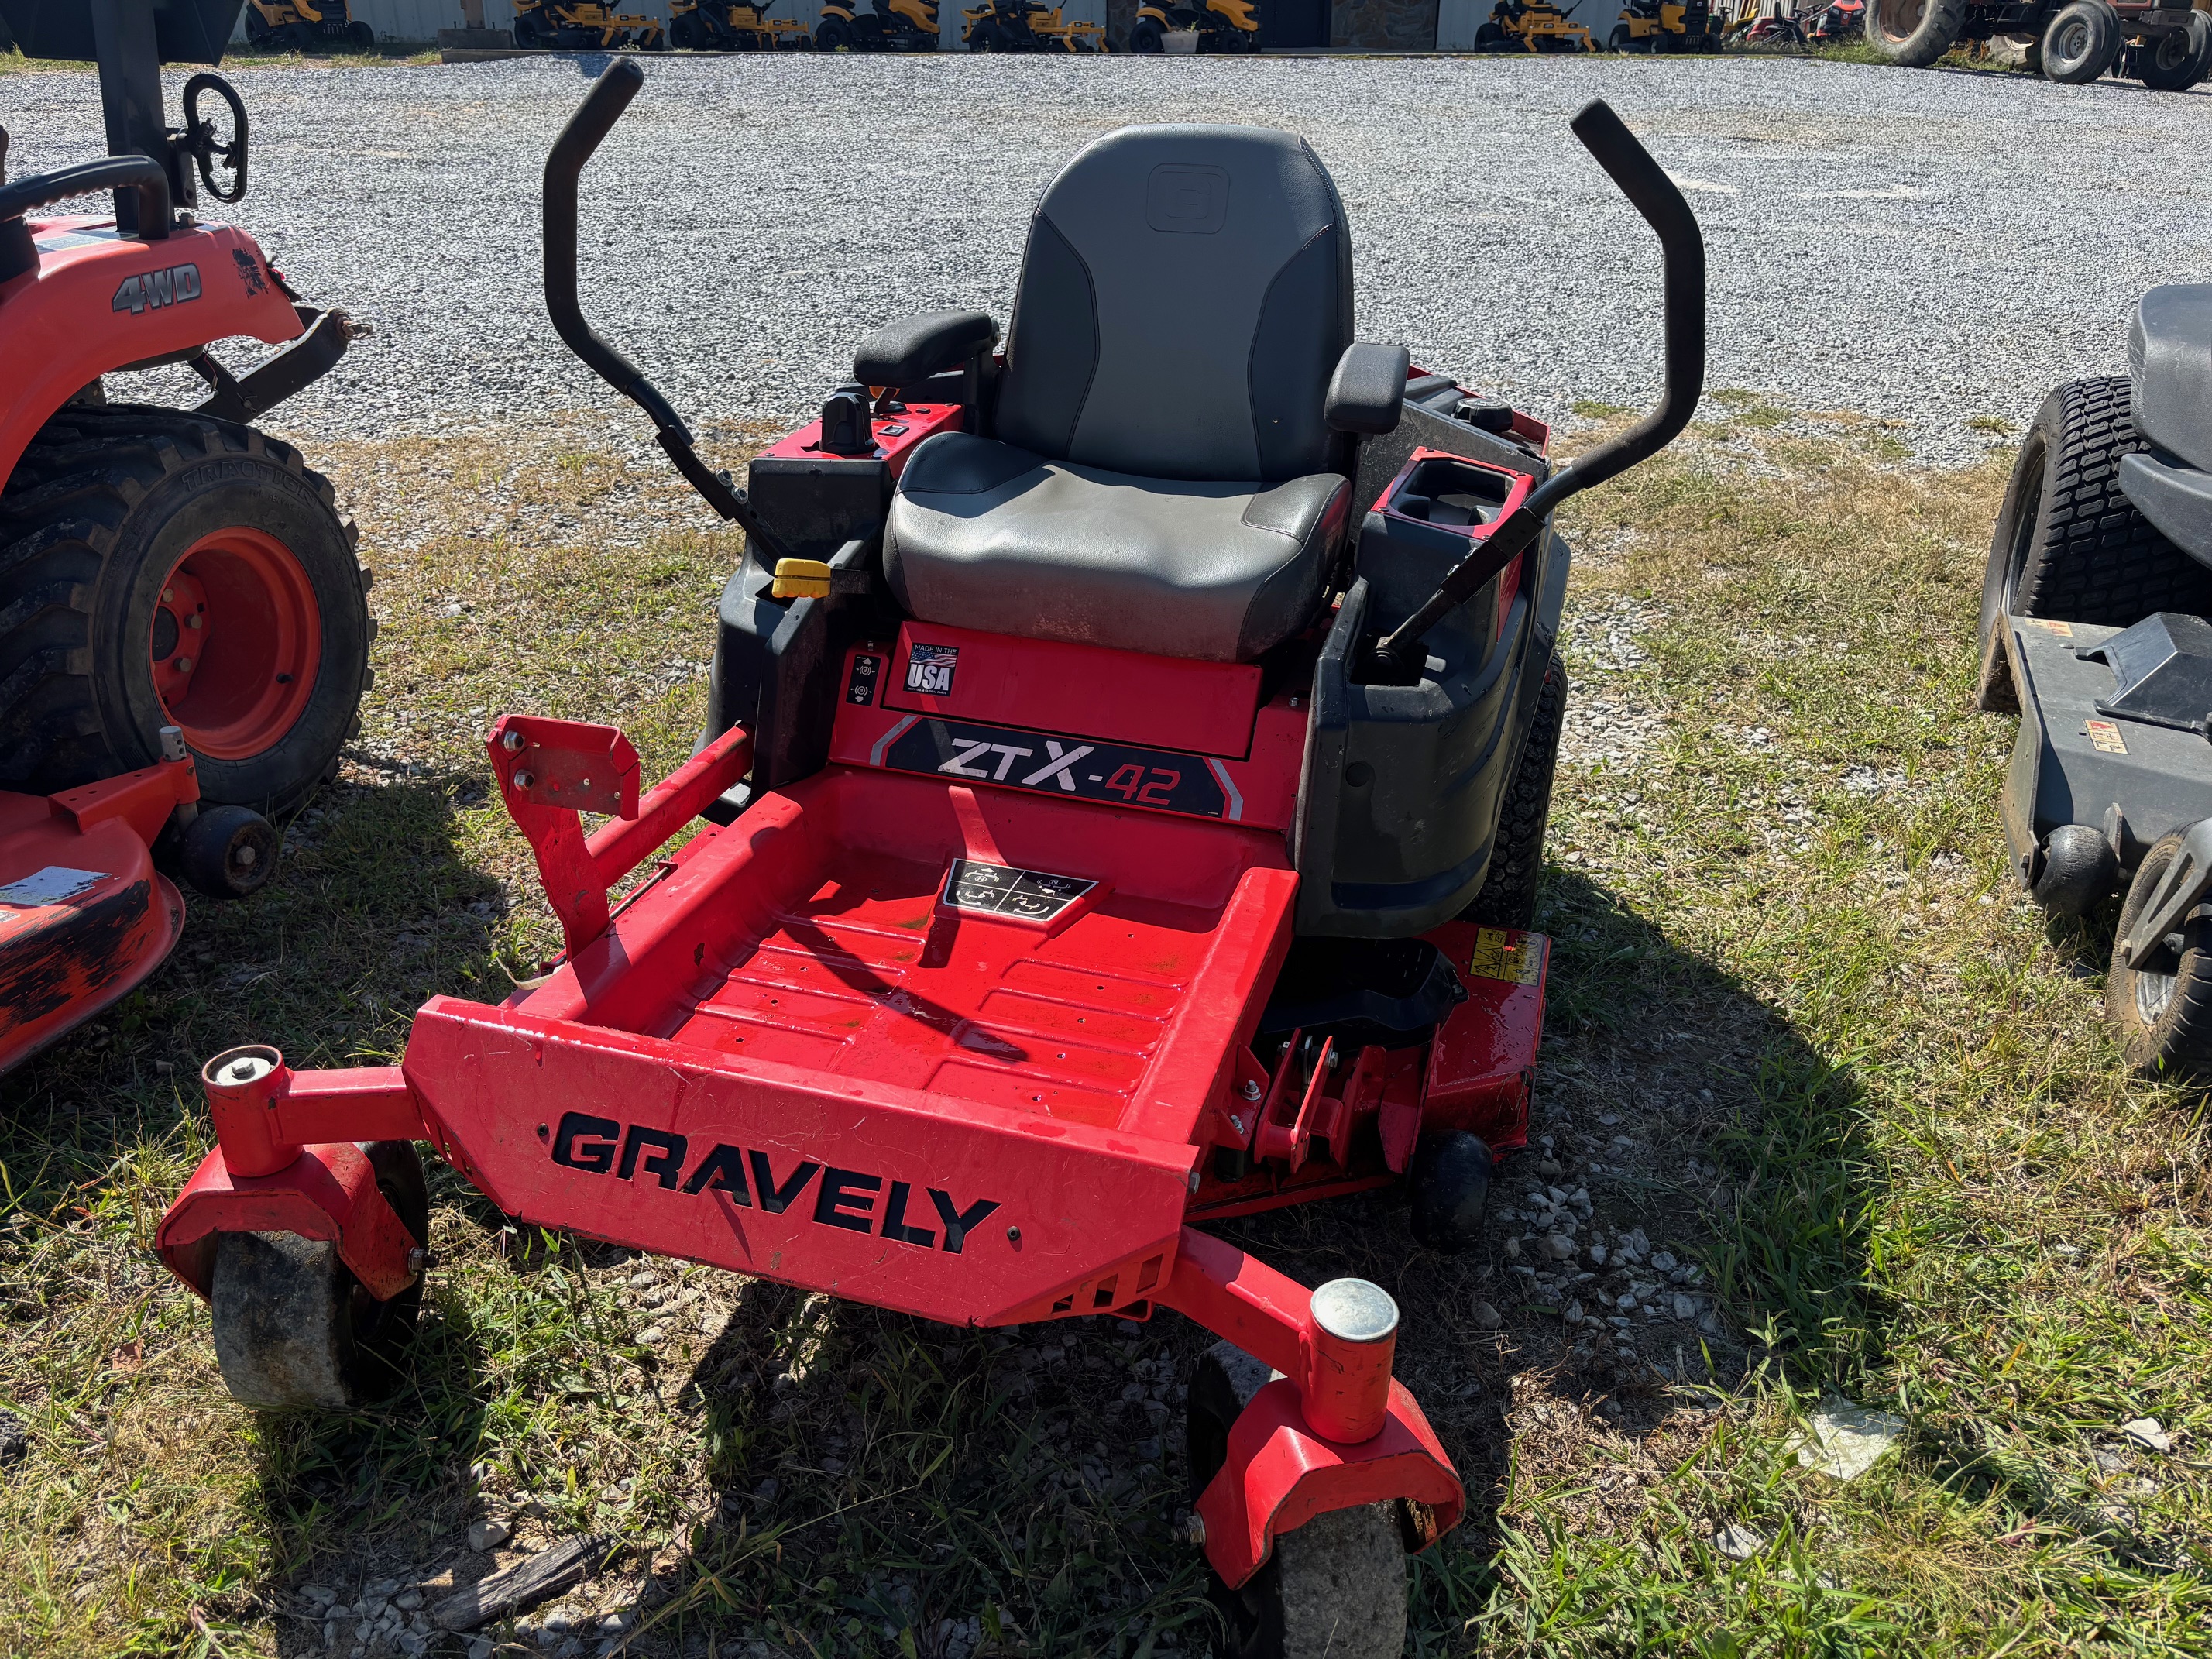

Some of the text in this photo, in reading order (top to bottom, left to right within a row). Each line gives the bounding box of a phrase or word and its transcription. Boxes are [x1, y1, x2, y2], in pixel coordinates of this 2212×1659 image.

[112, 263, 202, 315] 4WD
[181, 461, 318, 508] TRACTION
[915, 644, 934, 653] MADE
[908, 664, 950, 691] USA
[937, 737, 1181, 805] ZTX-42
[551, 1110, 1002, 1255] GRAVELY
